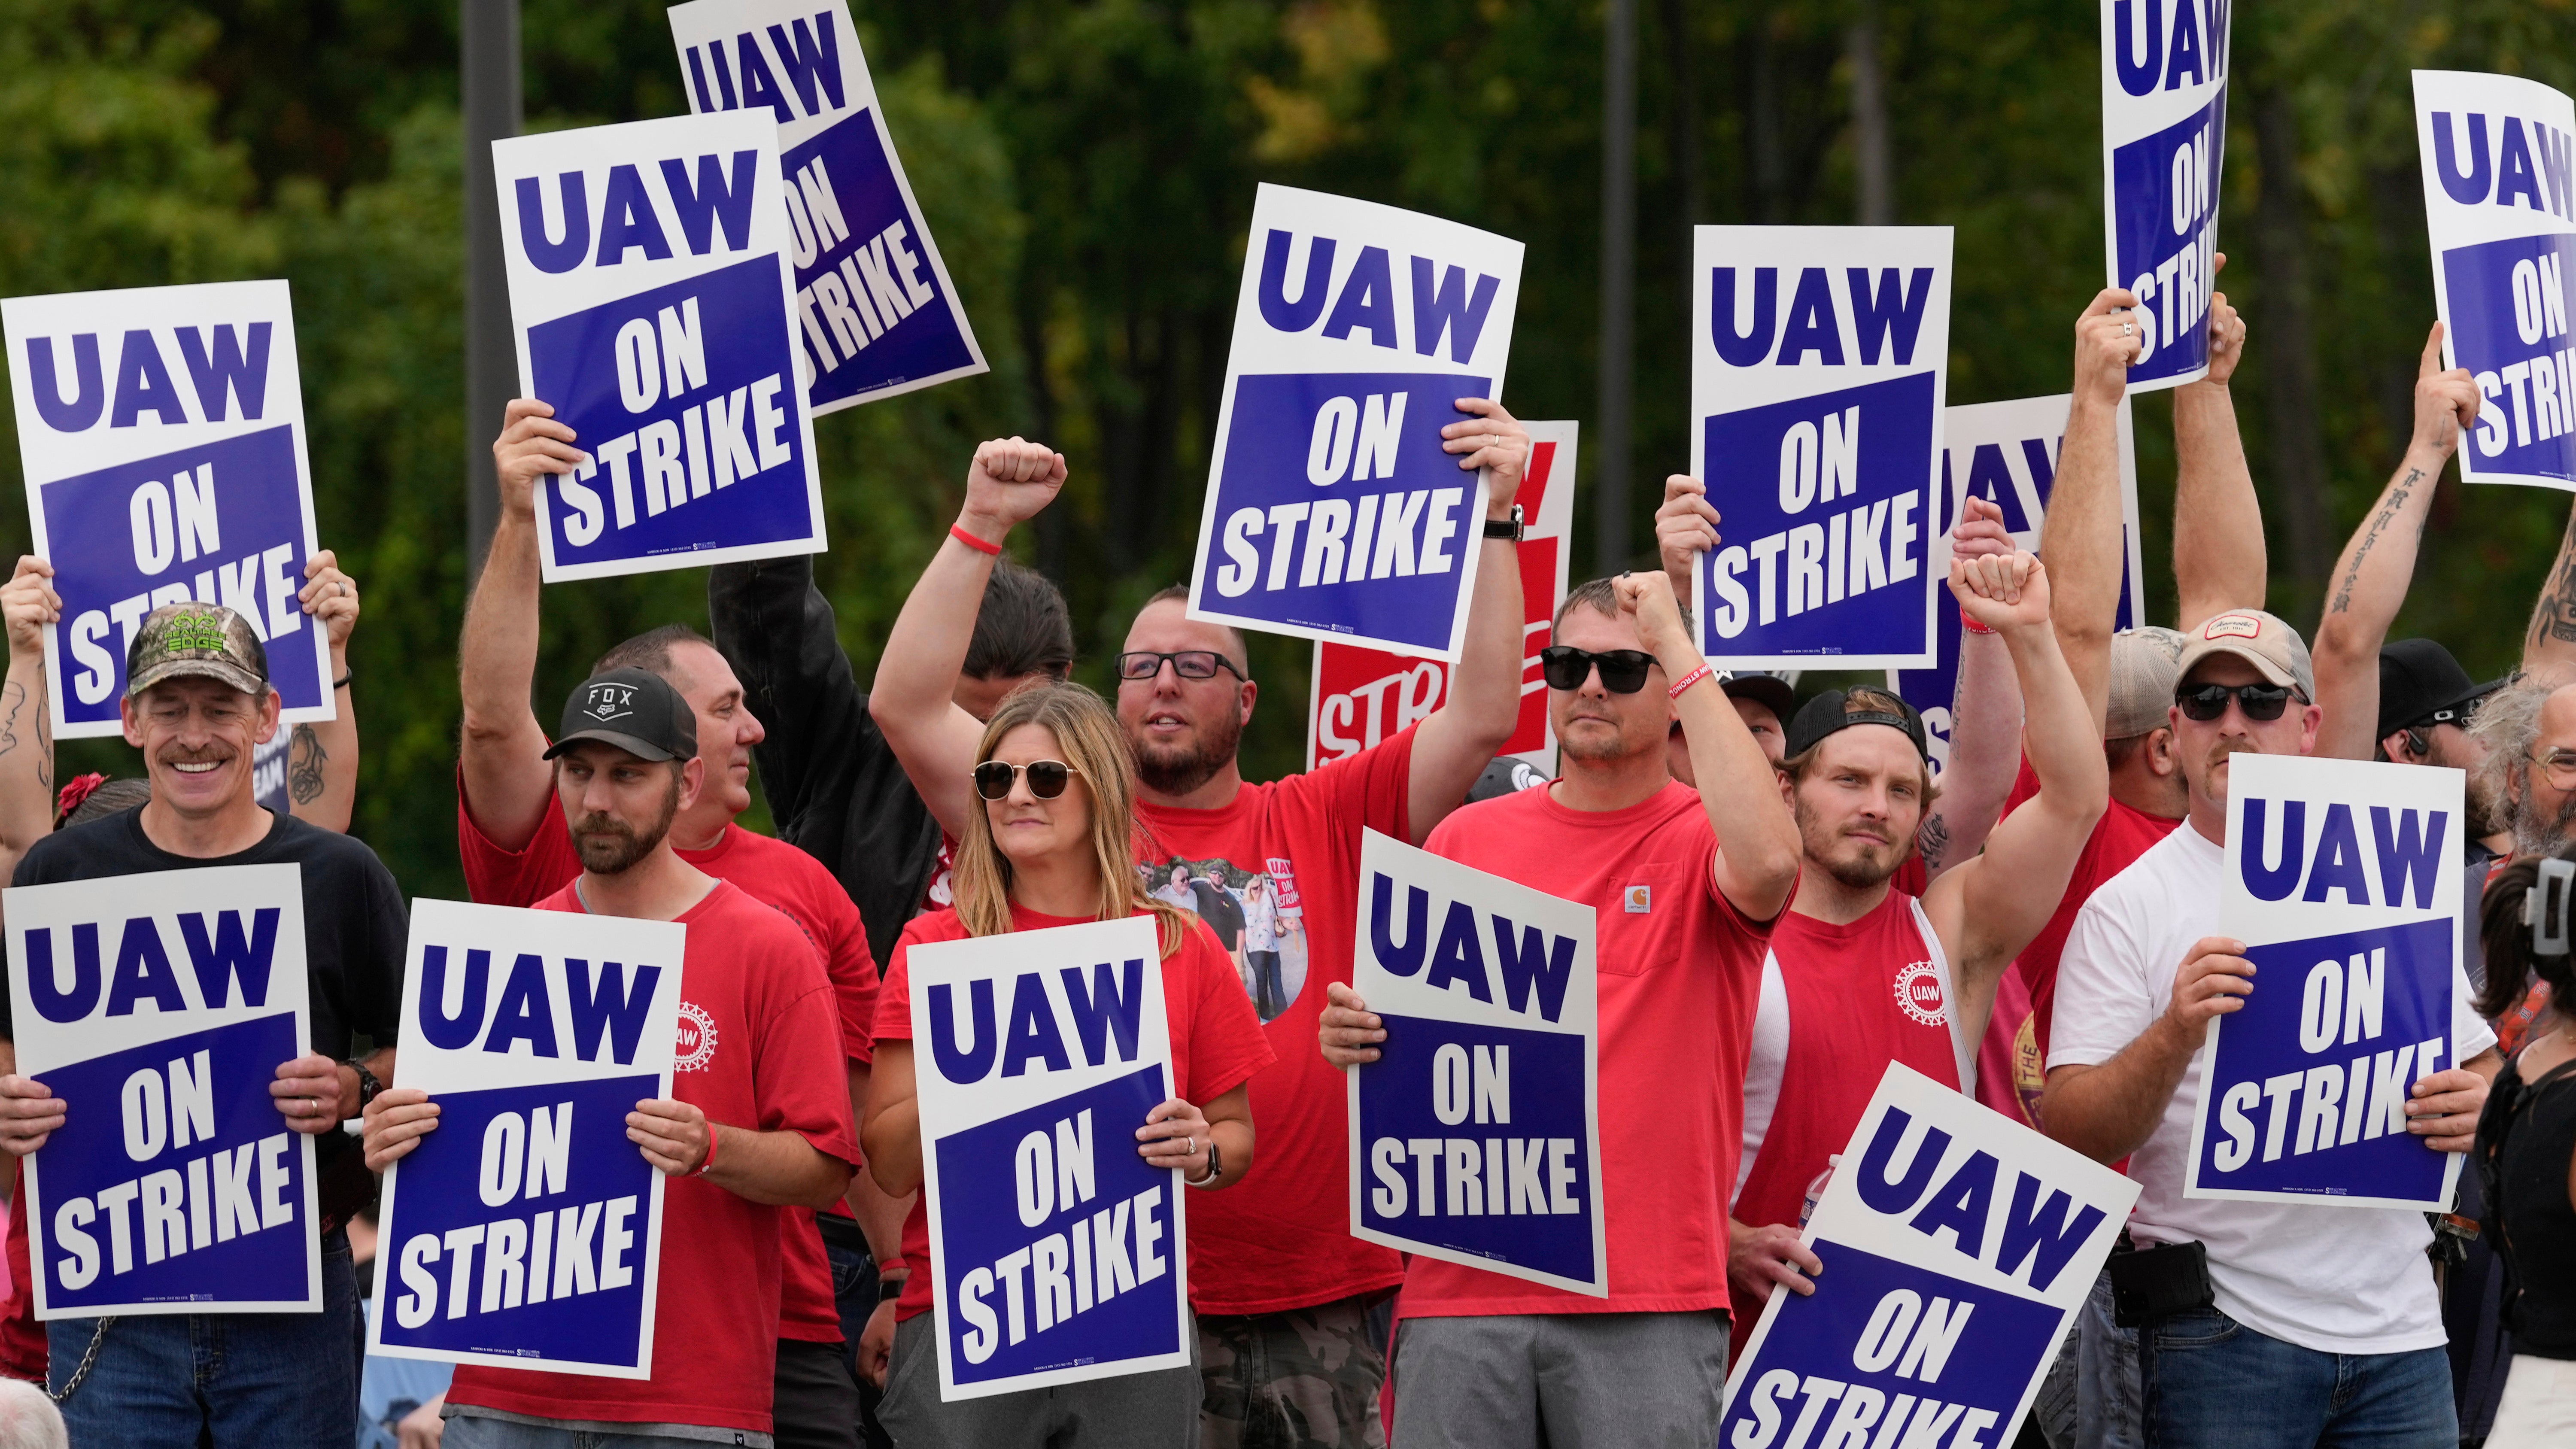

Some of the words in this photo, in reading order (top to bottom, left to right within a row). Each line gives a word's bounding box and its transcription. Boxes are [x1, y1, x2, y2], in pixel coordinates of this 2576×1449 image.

[686, 10, 847, 125] UAW
[2114, 0, 2227, 96] UAW
[515, 149, 757, 273] UAW
[782, 155, 850, 269] ON
[2172, 122, 2209, 236] ON
[2431, 112, 2573, 223] UAW
[1258, 229, 1501, 365] UAW
[1711, 267, 1934, 367] UAW
[2512, 252, 2567, 345] ON
[26, 322, 272, 433] UAW
[614, 296, 708, 414] ON
[558, 373, 792, 547] STRIKE
[1307, 392, 1408, 487] ON
[1778, 405, 1859, 514] ON
[130, 462, 221, 576] ON
[1217, 487, 1463, 598] STRIKE
[1714, 489, 1918, 639] STRIKE
[164, 628, 226, 640] REALTREE
[168, 636, 223, 652] EDGE
[1672, 671, 1700, 694] STRONG
[588, 688, 632, 706] FOX
[1278, 890, 1300, 908] STRIK
[1281, 878, 1294, 893] ON
[2241, 797, 2448, 910] UAW
[25, 907, 280, 1024] UAW
[1370, 871, 1577, 1024] UAW
[1912, 985, 1940, 1001] UAW
[2299, 947, 2385, 1054] ON
[418, 945, 661, 1065] UAW
[677, 1028, 699, 1047] AW
[927, 958, 1144, 1085] UAW
[122, 1049, 215, 1162] ON
[1433, 1043, 1510, 1126] ON
[2023, 1044, 2038, 1081] THE
[479, 1101, 573, 1207] ON
[1015, 1108, 1096, 1227] ON
[1371, 1137, 1580, 1219] STRIKE
[1856, 1105, 2107, 1292] UAW
[55, 1132, 293, 1290] STRIKE
[396, 1195, 637, 1329] STRIKE
[959, 1185, 1166, 1364] STRIKE
[1853, 1288, 1975, 1383] ON
